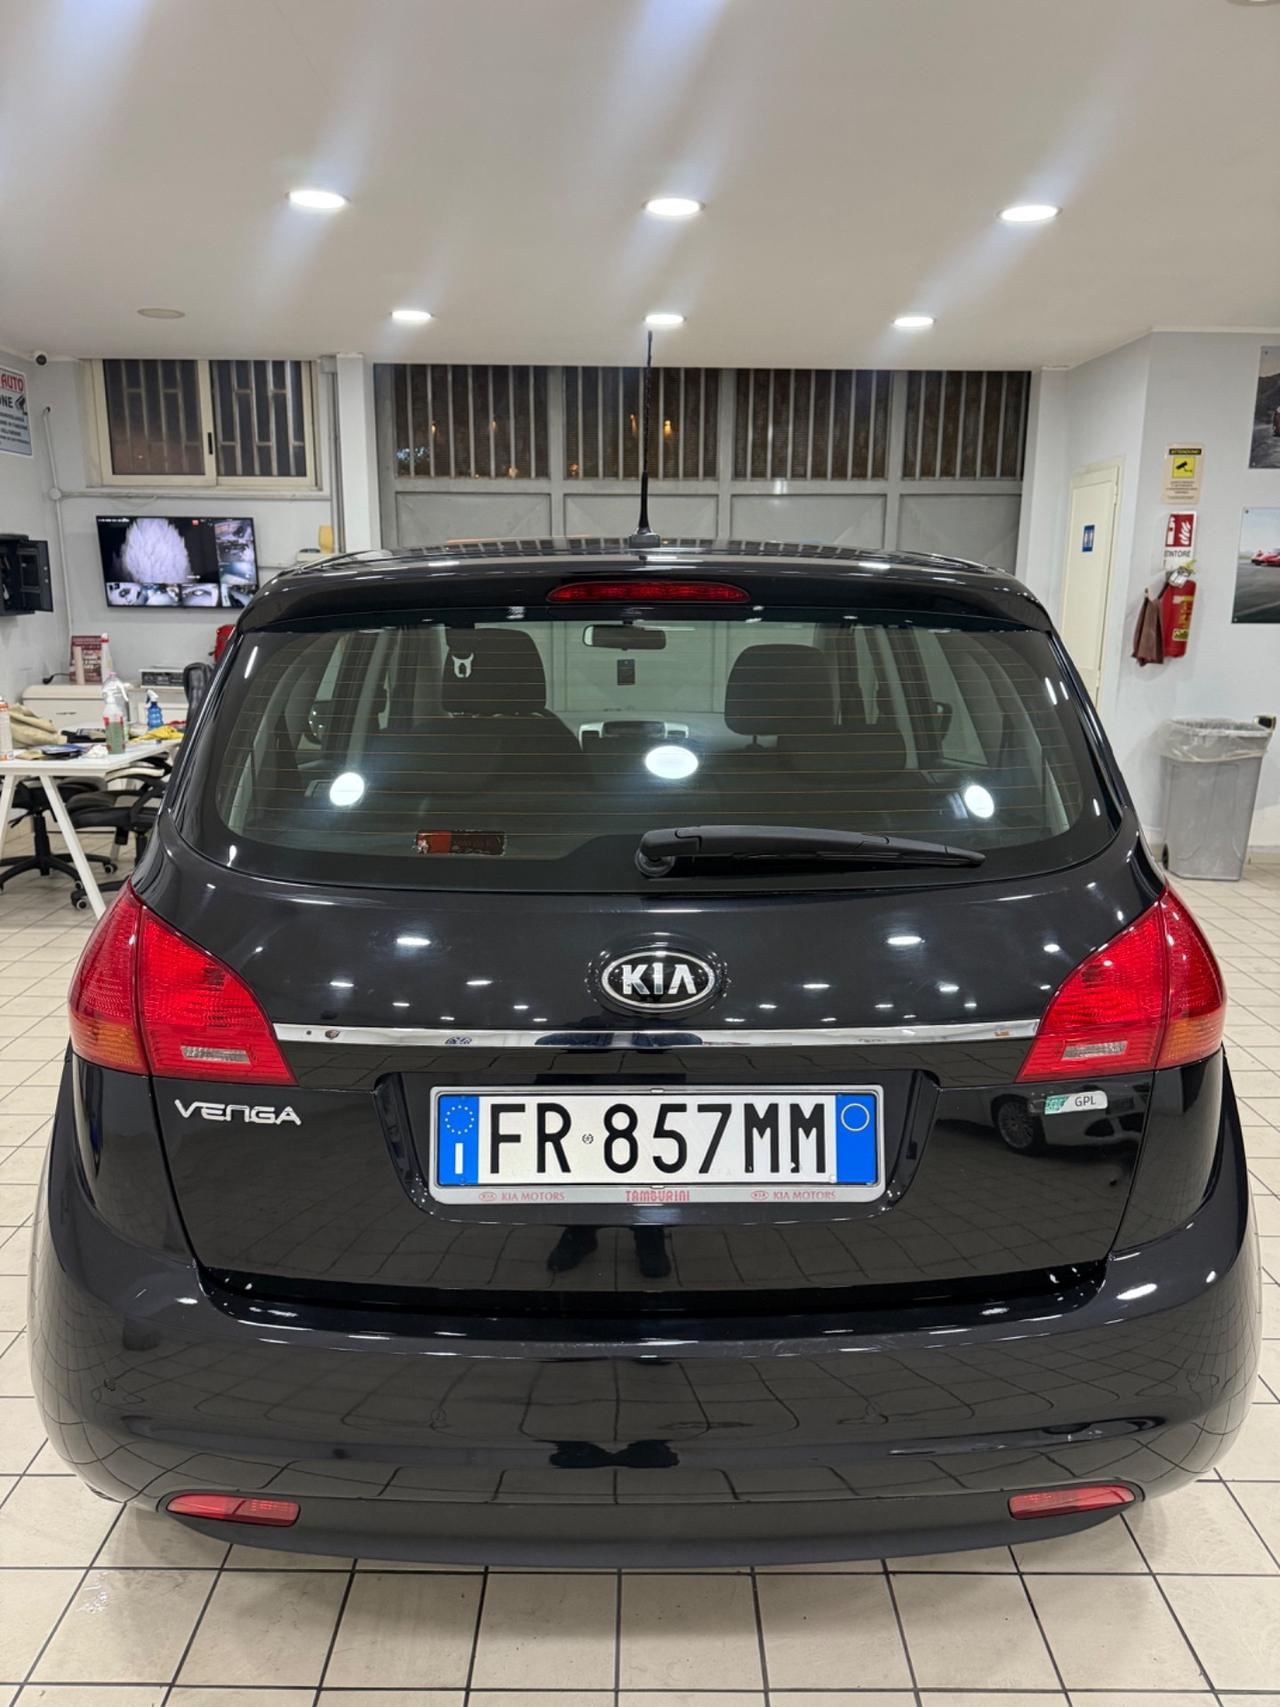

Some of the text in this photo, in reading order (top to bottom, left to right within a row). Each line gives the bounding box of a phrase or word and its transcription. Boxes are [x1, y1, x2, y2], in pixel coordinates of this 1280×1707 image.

[1, 373, 24, 391] AUTO
[0, 394, 13, 408] NE
[621, 962, 698, 995] KIA
[1074, 1096, 1097, 1107] GPL
[174, 1099, 302, 1126] VENGA
[489, 1102, 572, 1174] FR
[501, 1191, 566, 1201] KIA MOTORS
[625, 1190, 691, 1202] TAMBURINI
[773, 1190, 837, 1200] KIA MOTORS
